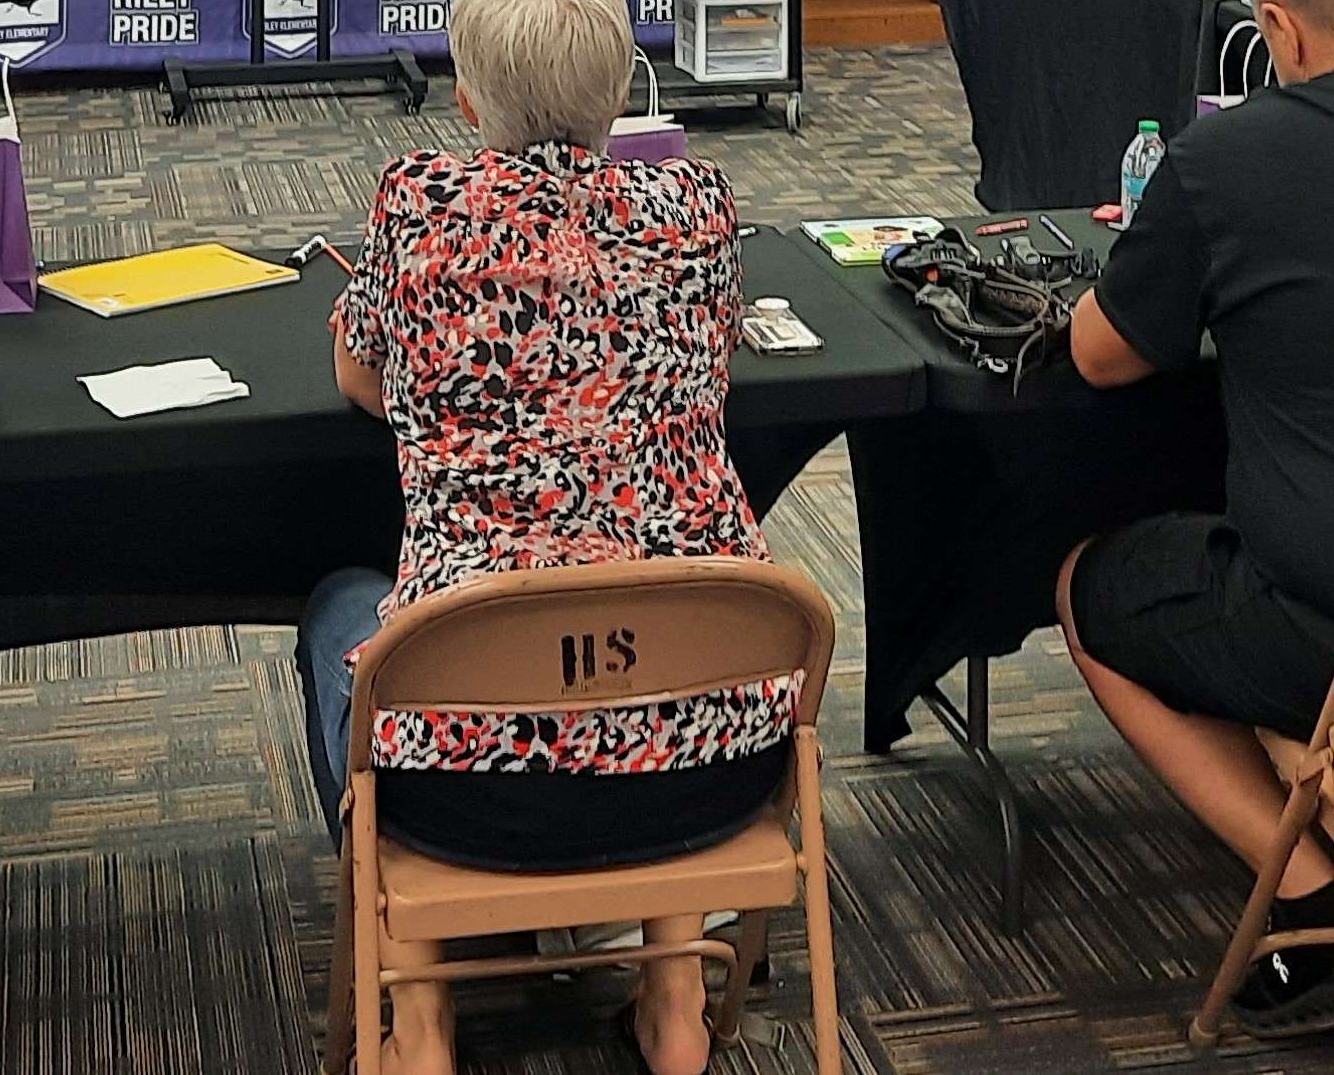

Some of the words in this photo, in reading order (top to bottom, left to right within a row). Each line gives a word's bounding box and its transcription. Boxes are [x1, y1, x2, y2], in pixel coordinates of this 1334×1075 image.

[113, 13, 196, 43] PRIDE
[280, 19, 318, 30] ELEMENTAR
[382, 4, 445, 33] PRID
